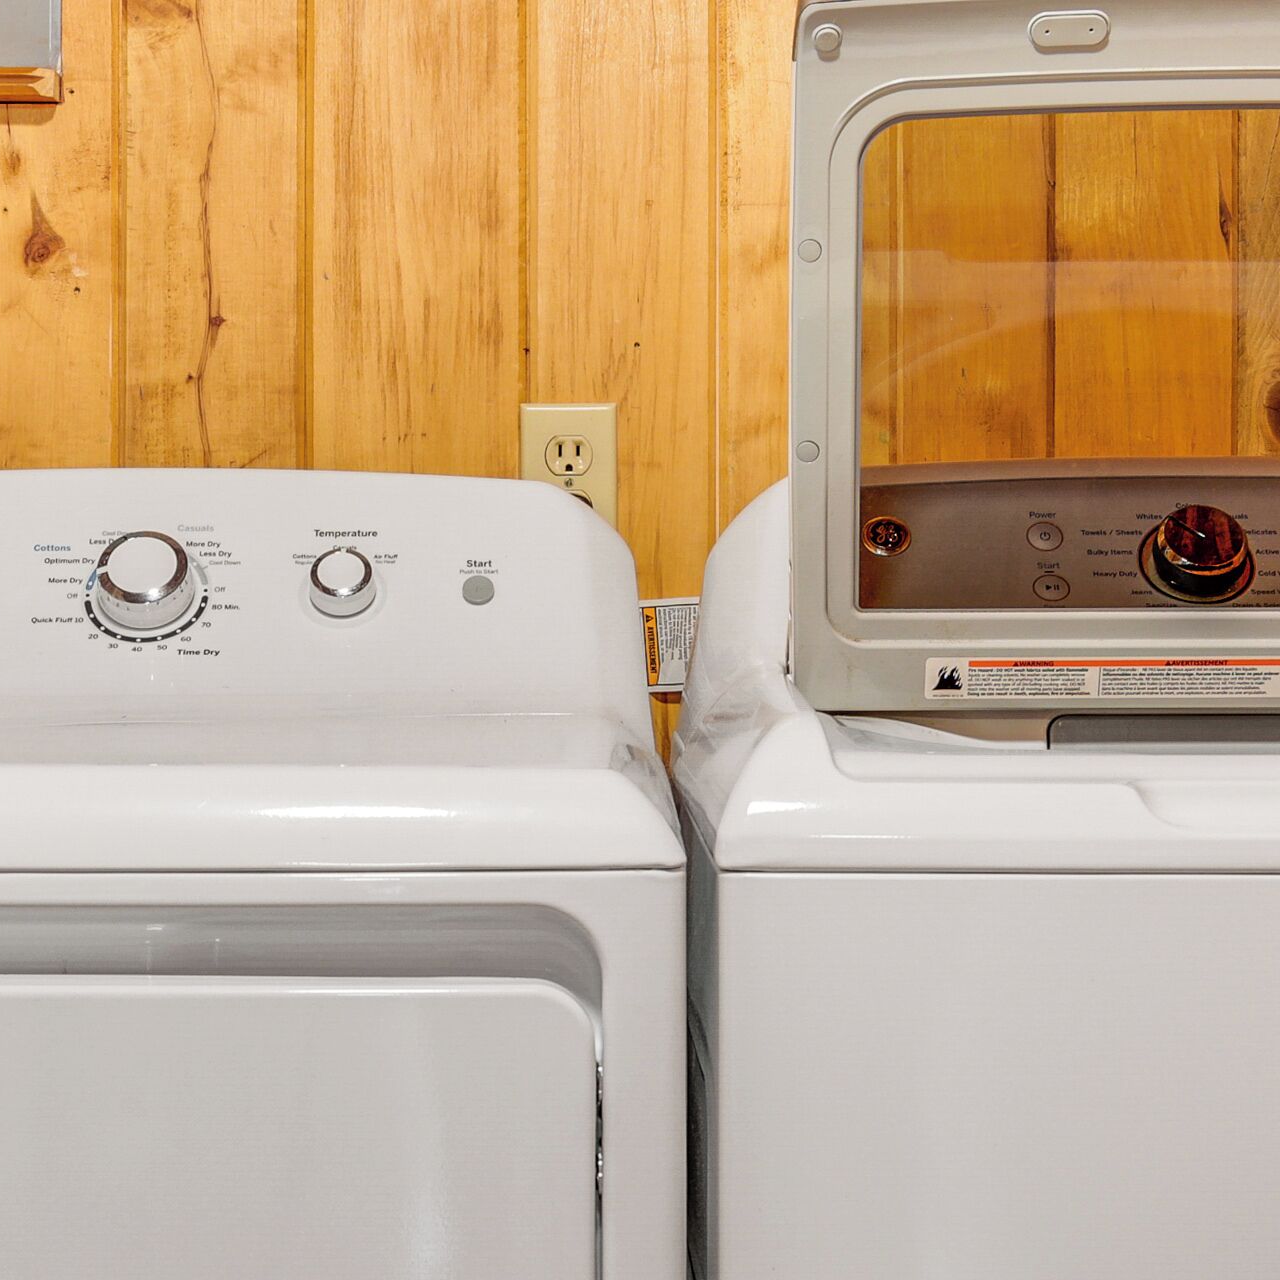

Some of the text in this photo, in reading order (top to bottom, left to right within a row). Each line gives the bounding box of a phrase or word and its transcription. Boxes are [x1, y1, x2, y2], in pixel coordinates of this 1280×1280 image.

[314, 529, 378, 538] Temperature
[33, 544, 71, 552] Cottons
[206, 540, 221, 548] Dry
[44, 557, 80, 565] Optimum
[466, 559, 492, 568] Start
[69, 577, 83, 585] Dry
[203, 649, 220, 657] Dry
[647, 625, 657, 674] AVERTISSEMENT
